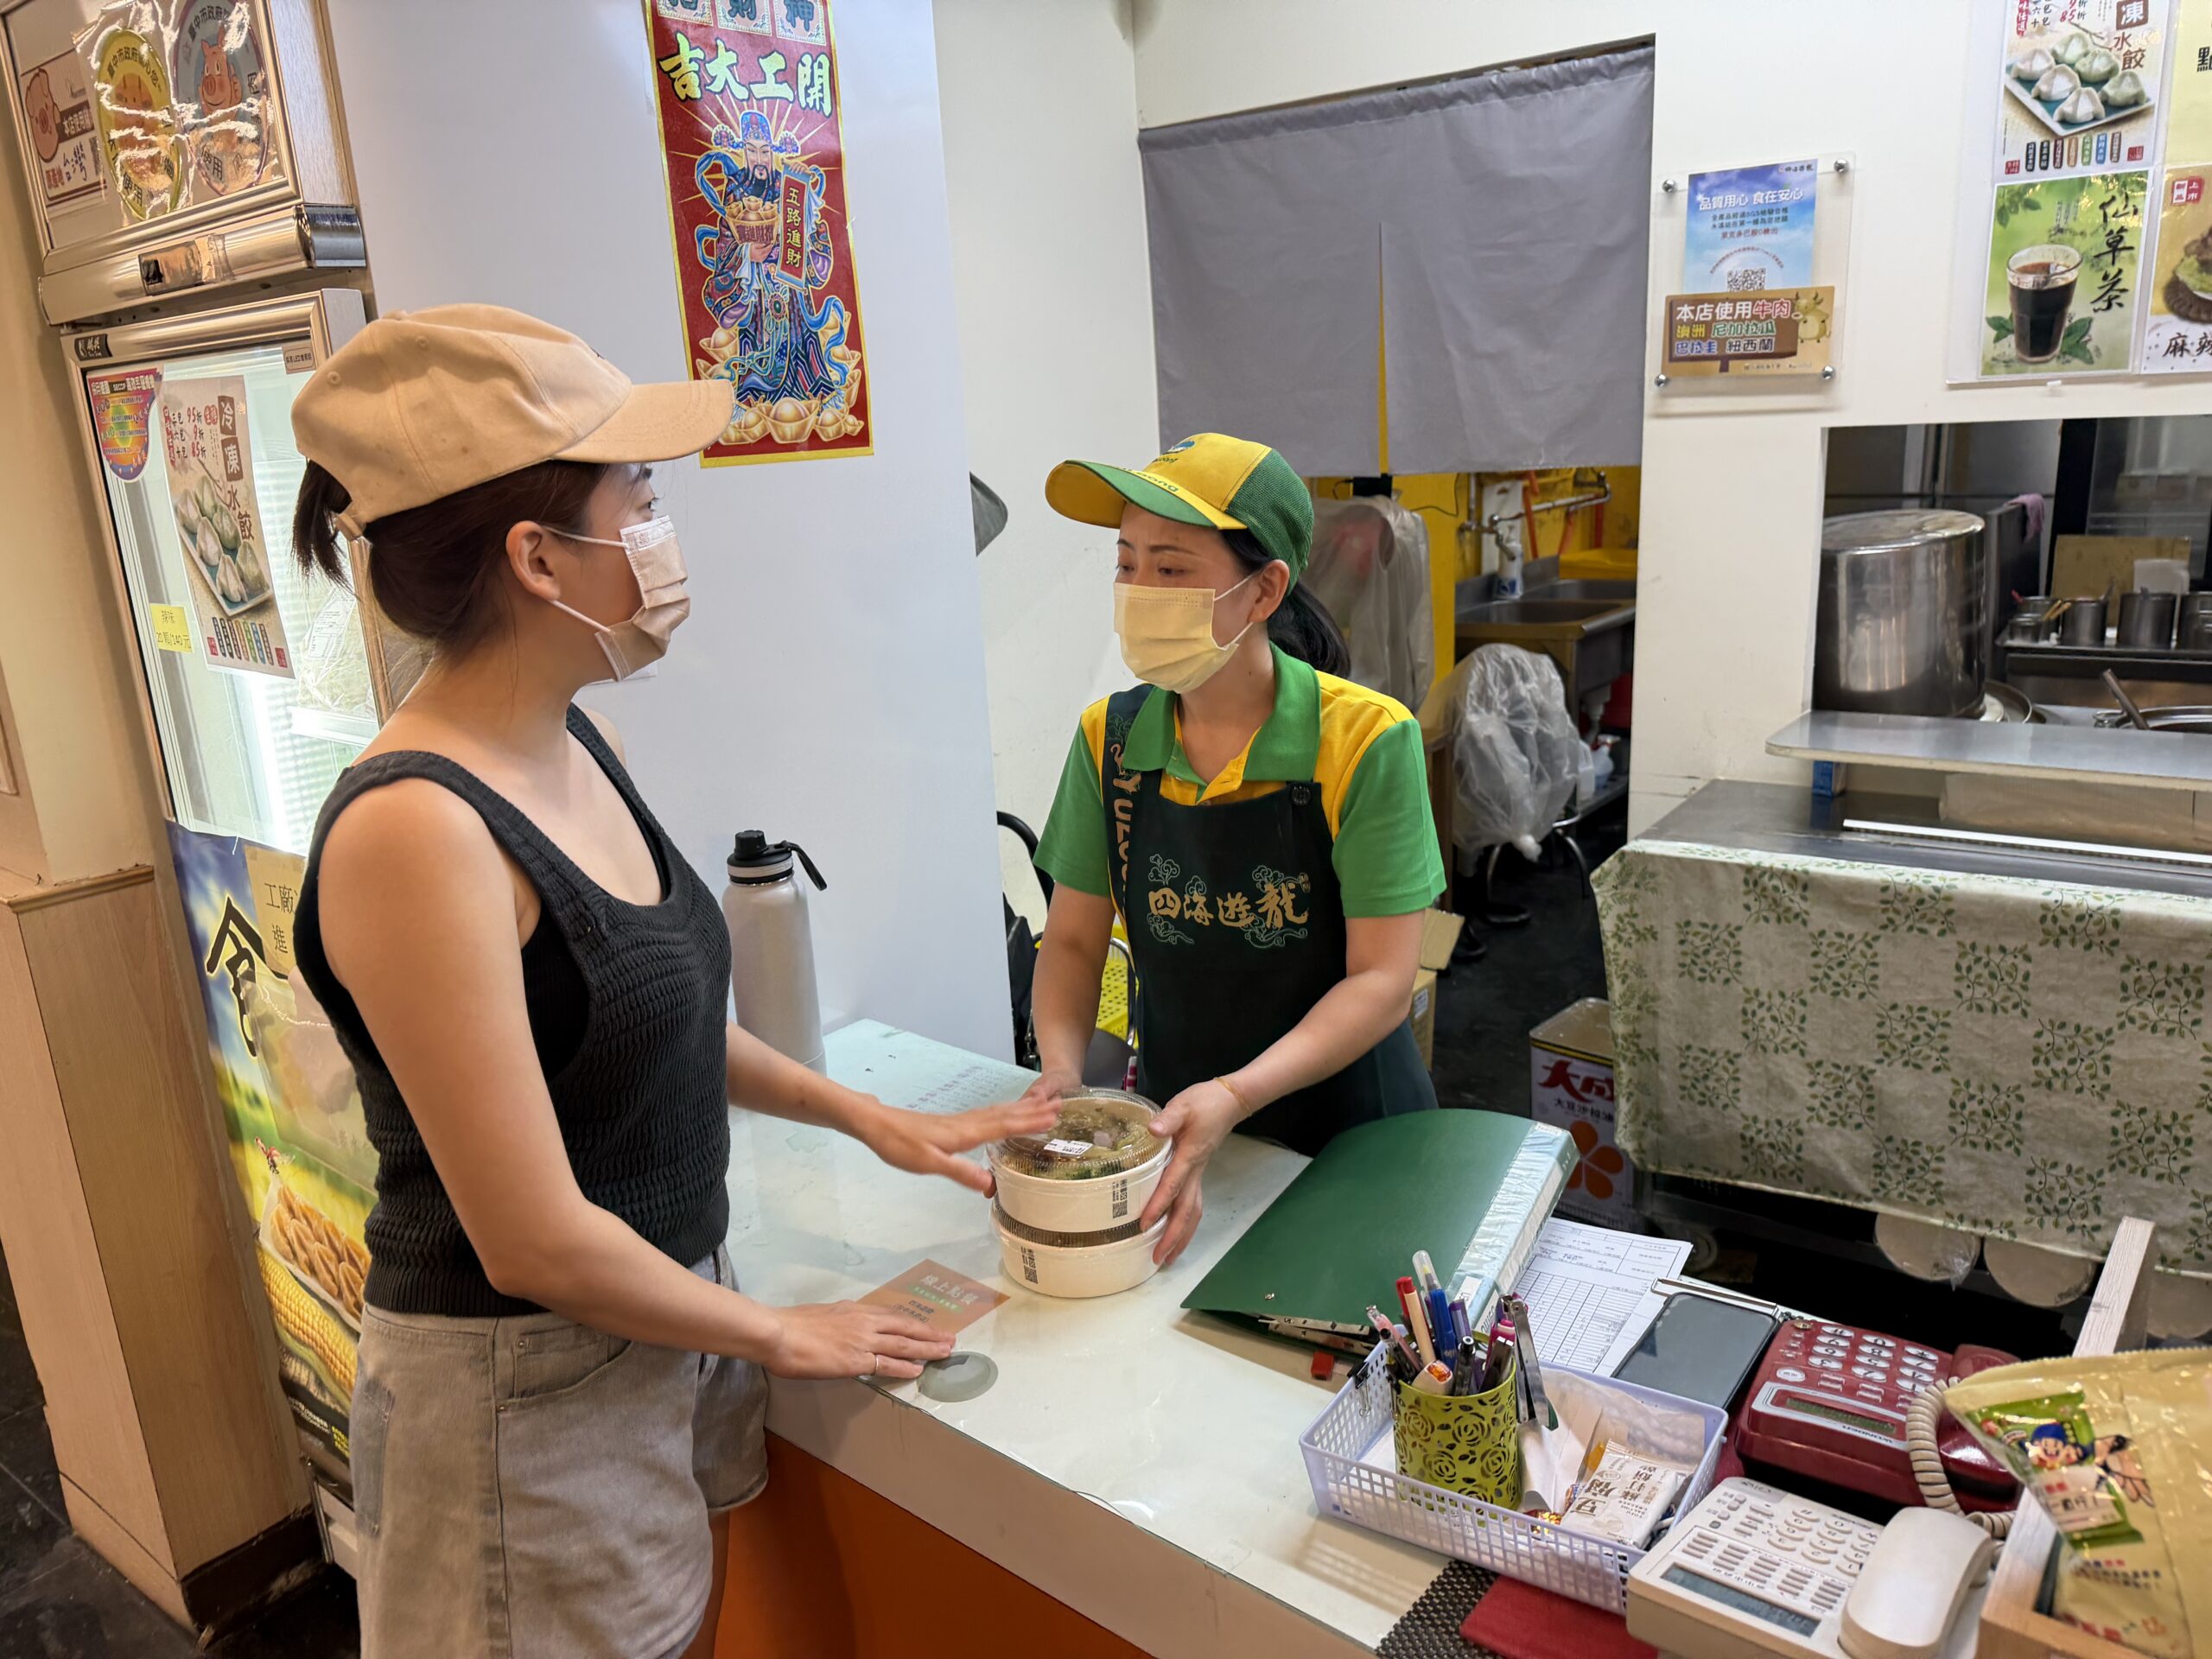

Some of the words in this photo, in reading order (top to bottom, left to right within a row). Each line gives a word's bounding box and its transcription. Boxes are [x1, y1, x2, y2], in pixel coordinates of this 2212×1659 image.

[1699, 193, 1749, 211] 品質用心
[1752, 188, 1804, 205] 食在安心
[786, 188, 802, 268] 五路進財
[2091, 192, 2139, 314] 仙草茶
[1675, 298, 1791, 321] 本店使用牛肉
[1675, 323, 1706, 338] 澳洲
[1712, 320, 1776, 338] 尼加拉瓜
[1675, 340, 1718, 356] 巴拉圭
[1726, 338, 1775, 353] 紐西蘭
[219, 399, 254, 542] 冷凍水餃
[264, 882, 297, 914] 工廠
[1147, 882, 1309, 929] 四海遊龍
[1570, 1478, 1617, 1517] 豆腐
